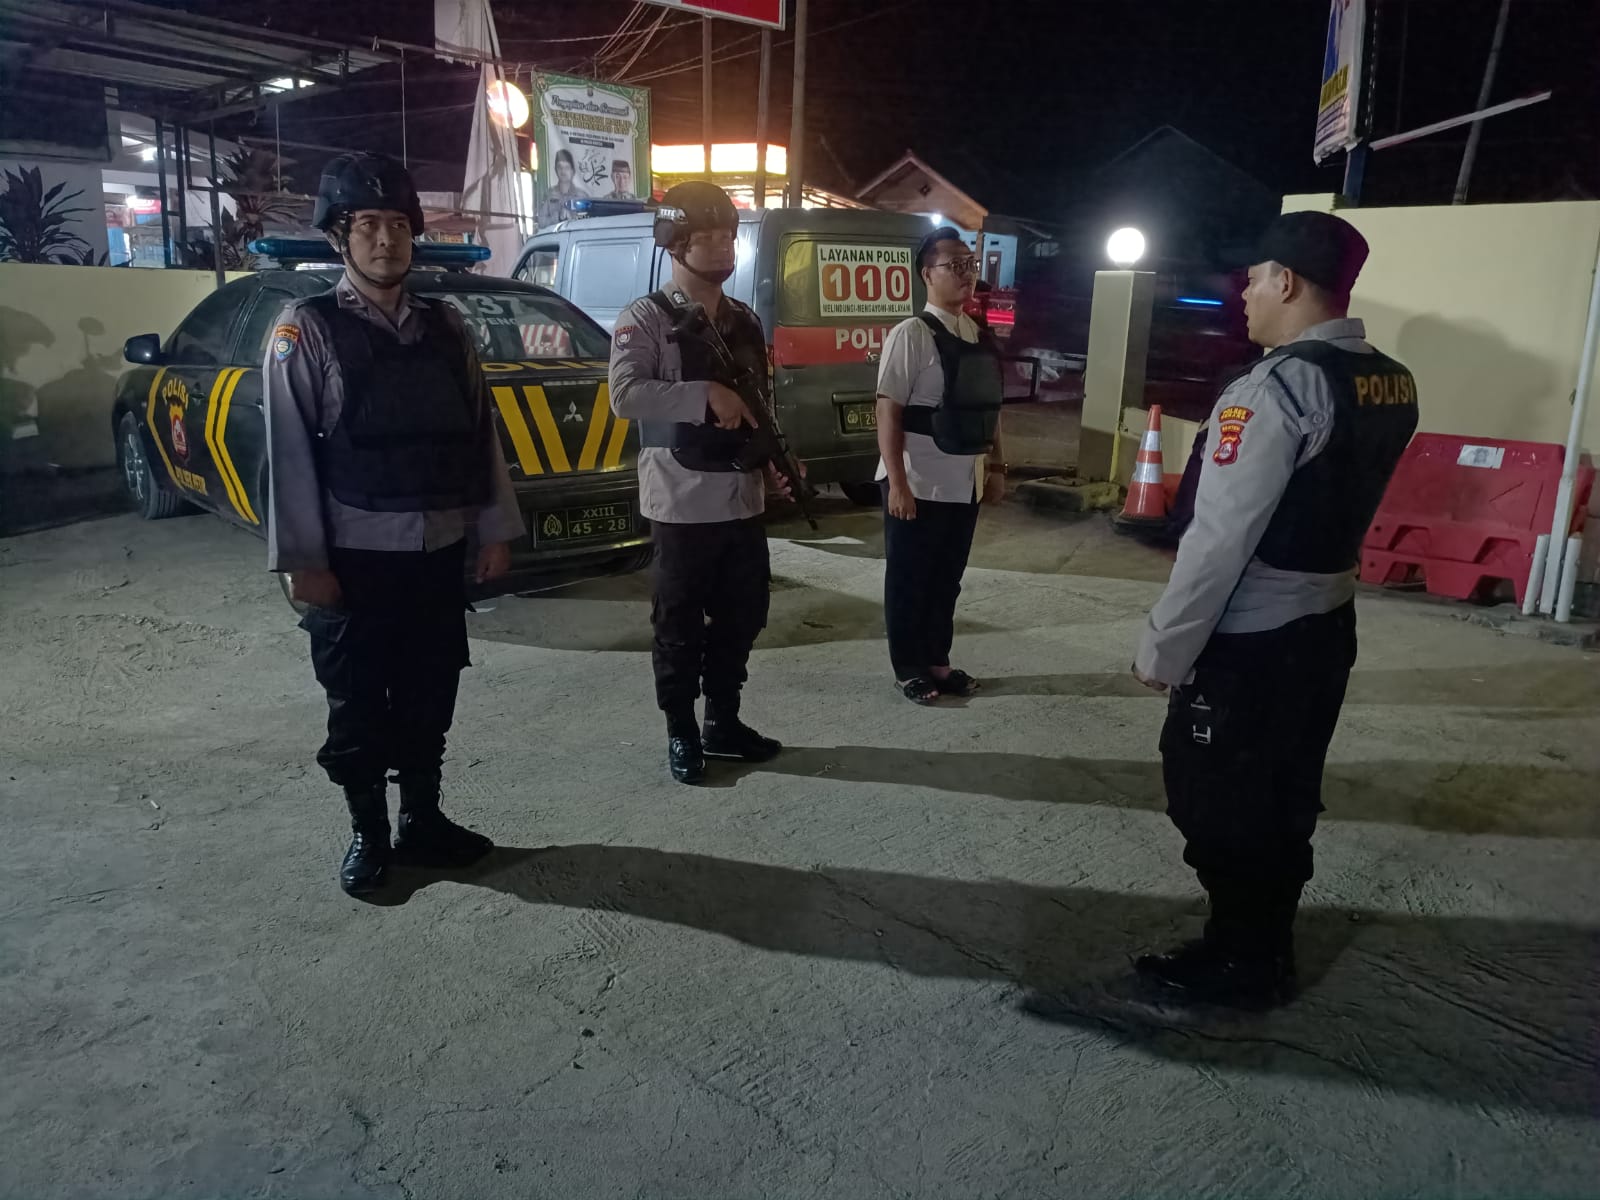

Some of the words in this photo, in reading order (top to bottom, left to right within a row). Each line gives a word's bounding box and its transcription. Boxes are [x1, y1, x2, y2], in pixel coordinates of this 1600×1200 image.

[821, 248, 873, 262] LAYANAN
[877, 250, 909, 263] POLISI
[830, 267, 905, 298] 110
[835, 328, 888, 350] POLI
[162, 378, 189, 411] POLISI
[1355, 375, 1413, 405] POLISI
[582, 506, 615, 519] XXIII
[572, 522, 592, 534] 45
[608, 518, 626, 532] 28
